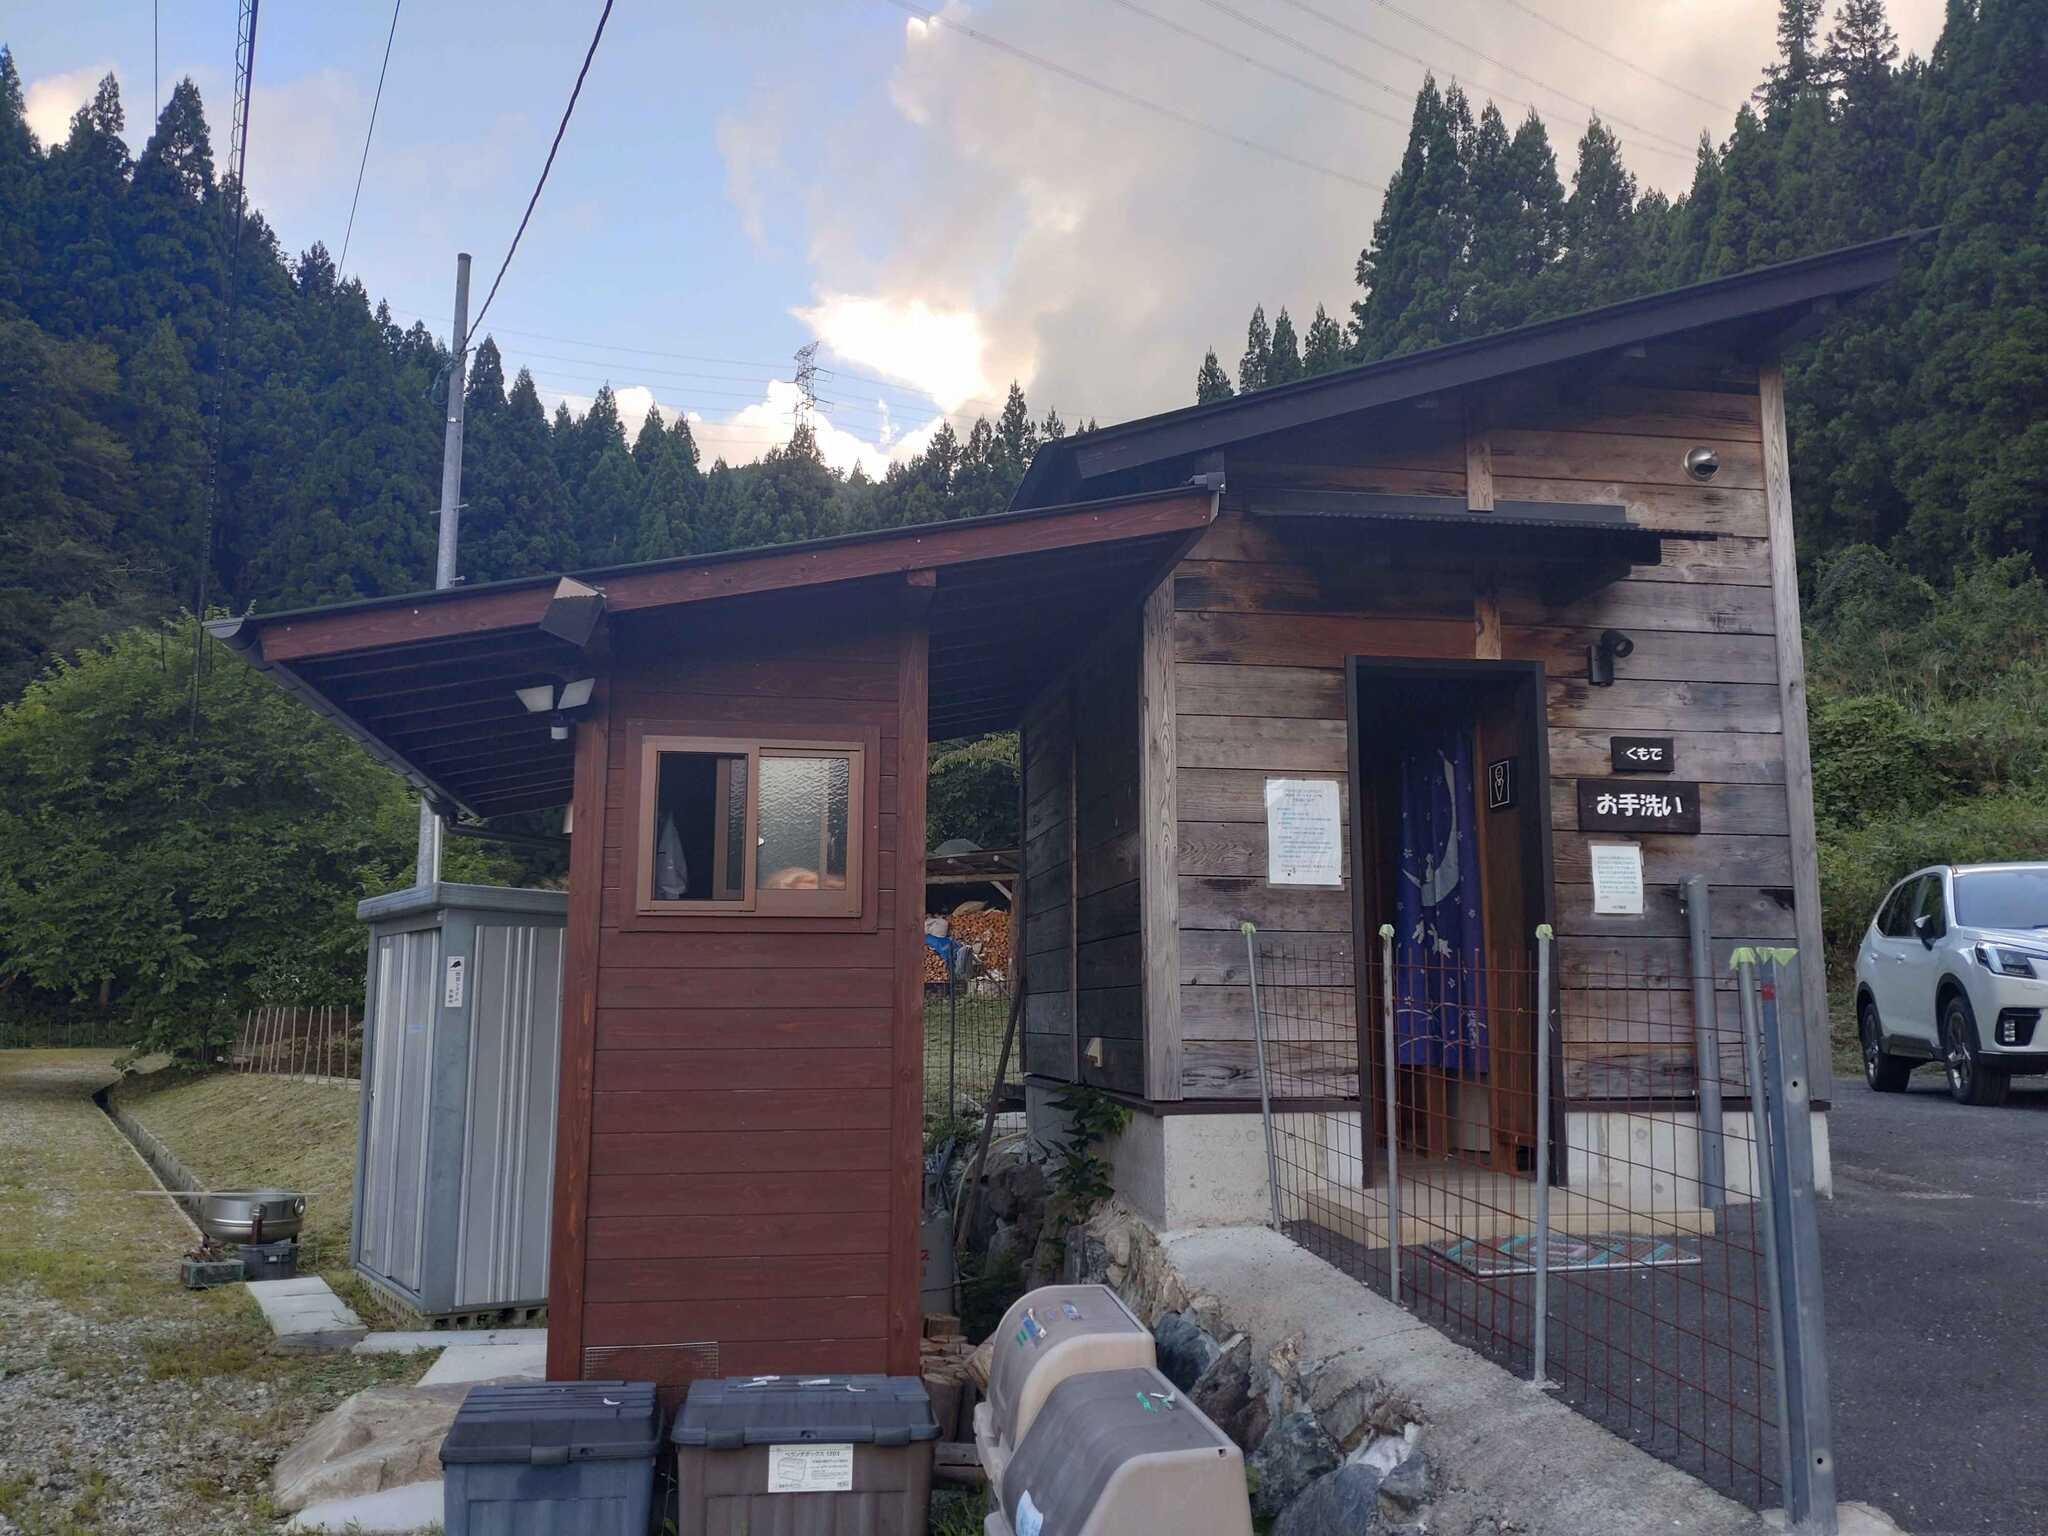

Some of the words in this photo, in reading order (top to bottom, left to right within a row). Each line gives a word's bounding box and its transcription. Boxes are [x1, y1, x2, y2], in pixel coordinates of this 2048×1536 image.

[1626, 747, 1663, 760] くもで
[1597, 793, 1683, 817] お手洗い
